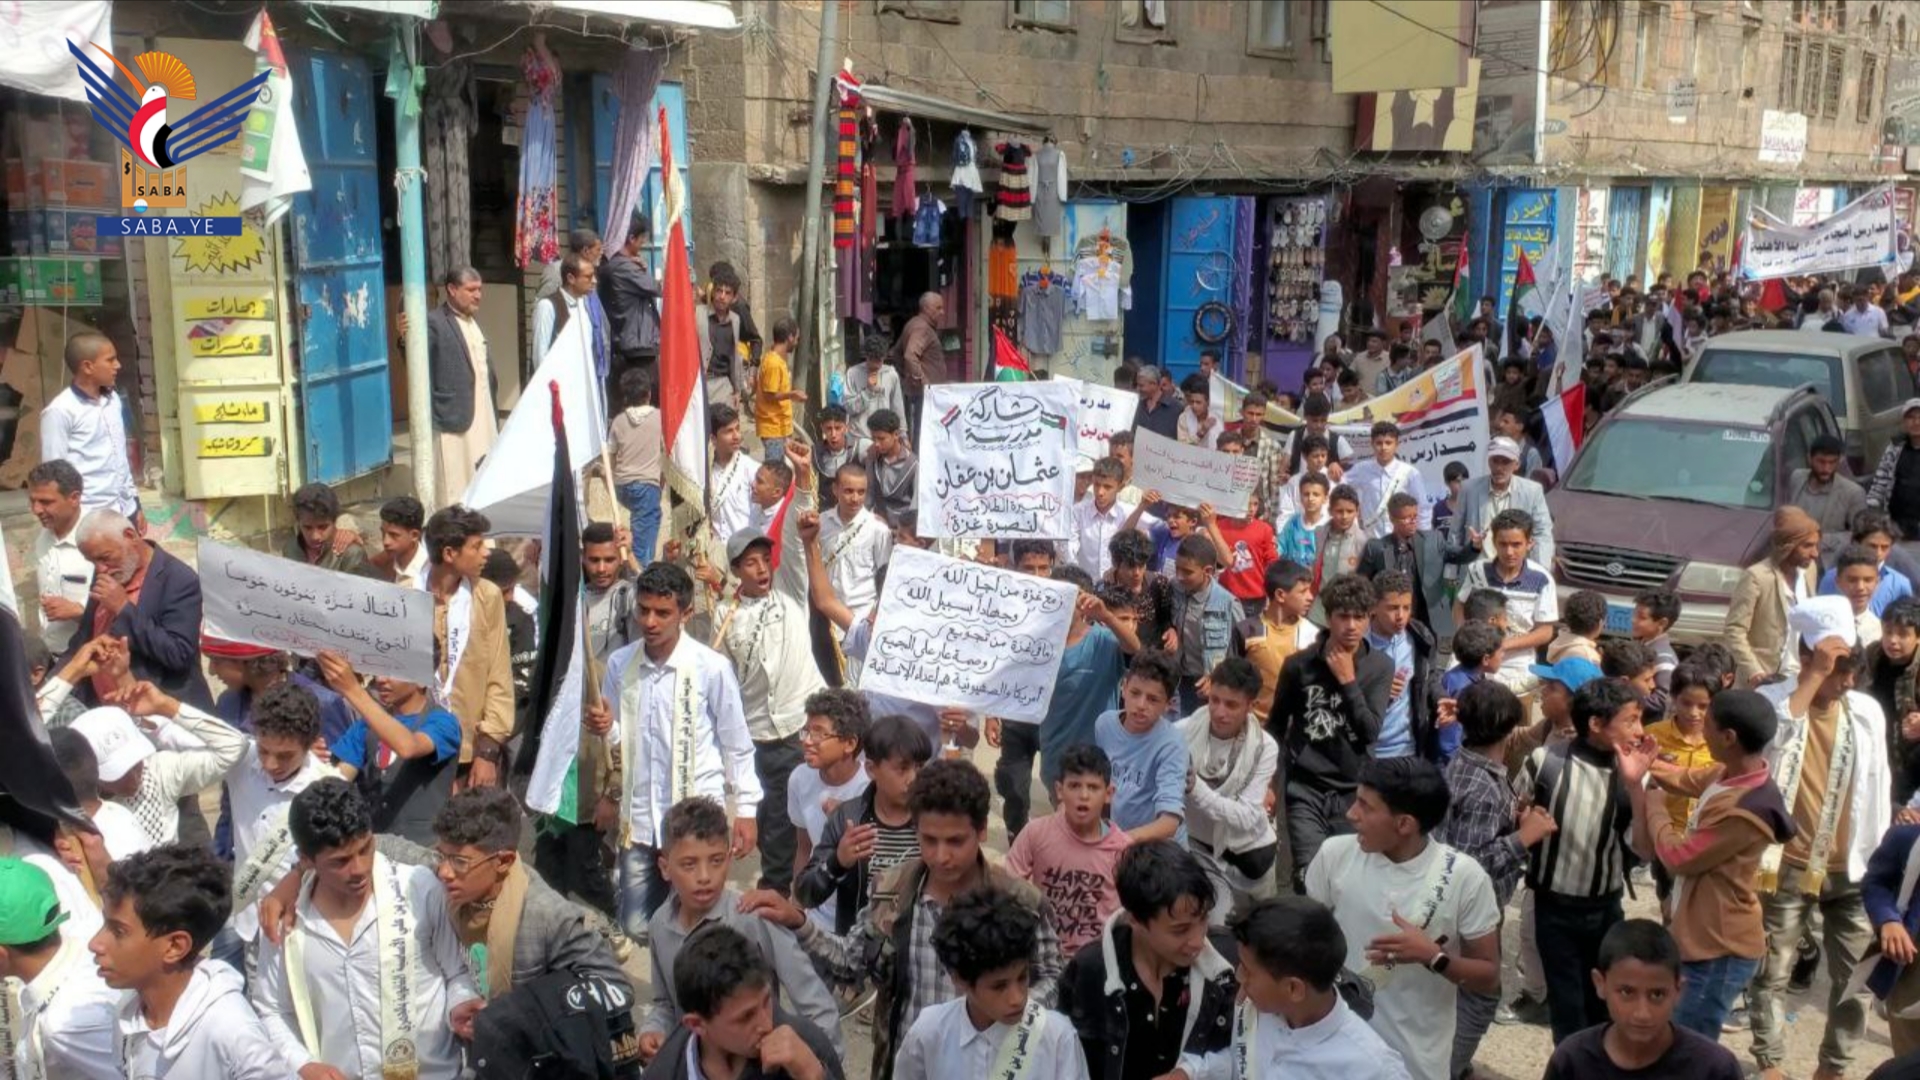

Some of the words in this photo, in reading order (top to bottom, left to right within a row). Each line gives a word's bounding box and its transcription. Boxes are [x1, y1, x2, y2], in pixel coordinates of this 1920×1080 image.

[206, 296, 255, 314] بهارات
[200, 336, 254, 354] مكسرات
[968, 387, 1039, 422] مشاركة
[965, 426, 1042, 444] مدرسة
[1410, 439, 1477, 463] مدارس
[936, 460, 976, 499] عفان
[996, 452, 1060, 489] عثمان
[974, 467, 995, 494] بن
[954, 498, 1009, 516] الطلابية
[951, 514, 982, 537] غزة
[987, 512, 1038, 534] لنصرة
[943, 568, 968, 585] الله
[967, 575, 1000, 594] أجل
[907, 585, 931, 601] الله
[1001, 585, 1019, 598] من
[1022, 588, 1042, 602] غزة
[930, 591, 973, 614] بسبيل
[881, 634, 914, 653] الجميع
[946, 626, 990, 645] تجويع
[990, 636, 1007, 650] من
[934, 643, 954, 661] عار
[1011, 639, 1032, 655] غزة
[954, 650, 988, 670] وصمة
[936, 674, 951, 695] هم
[1013, 685, 1043, 707] أمريكا
[1043, 866, 1105, 888] HARD
[1041, 881, 1105, 905] TIMES
[394, 905, 407, 917] بن
[1050, 901, 1097, 920] OOD
[391, 918, 412, 935] علي
[389, 937, 409, 972] الأساسية
